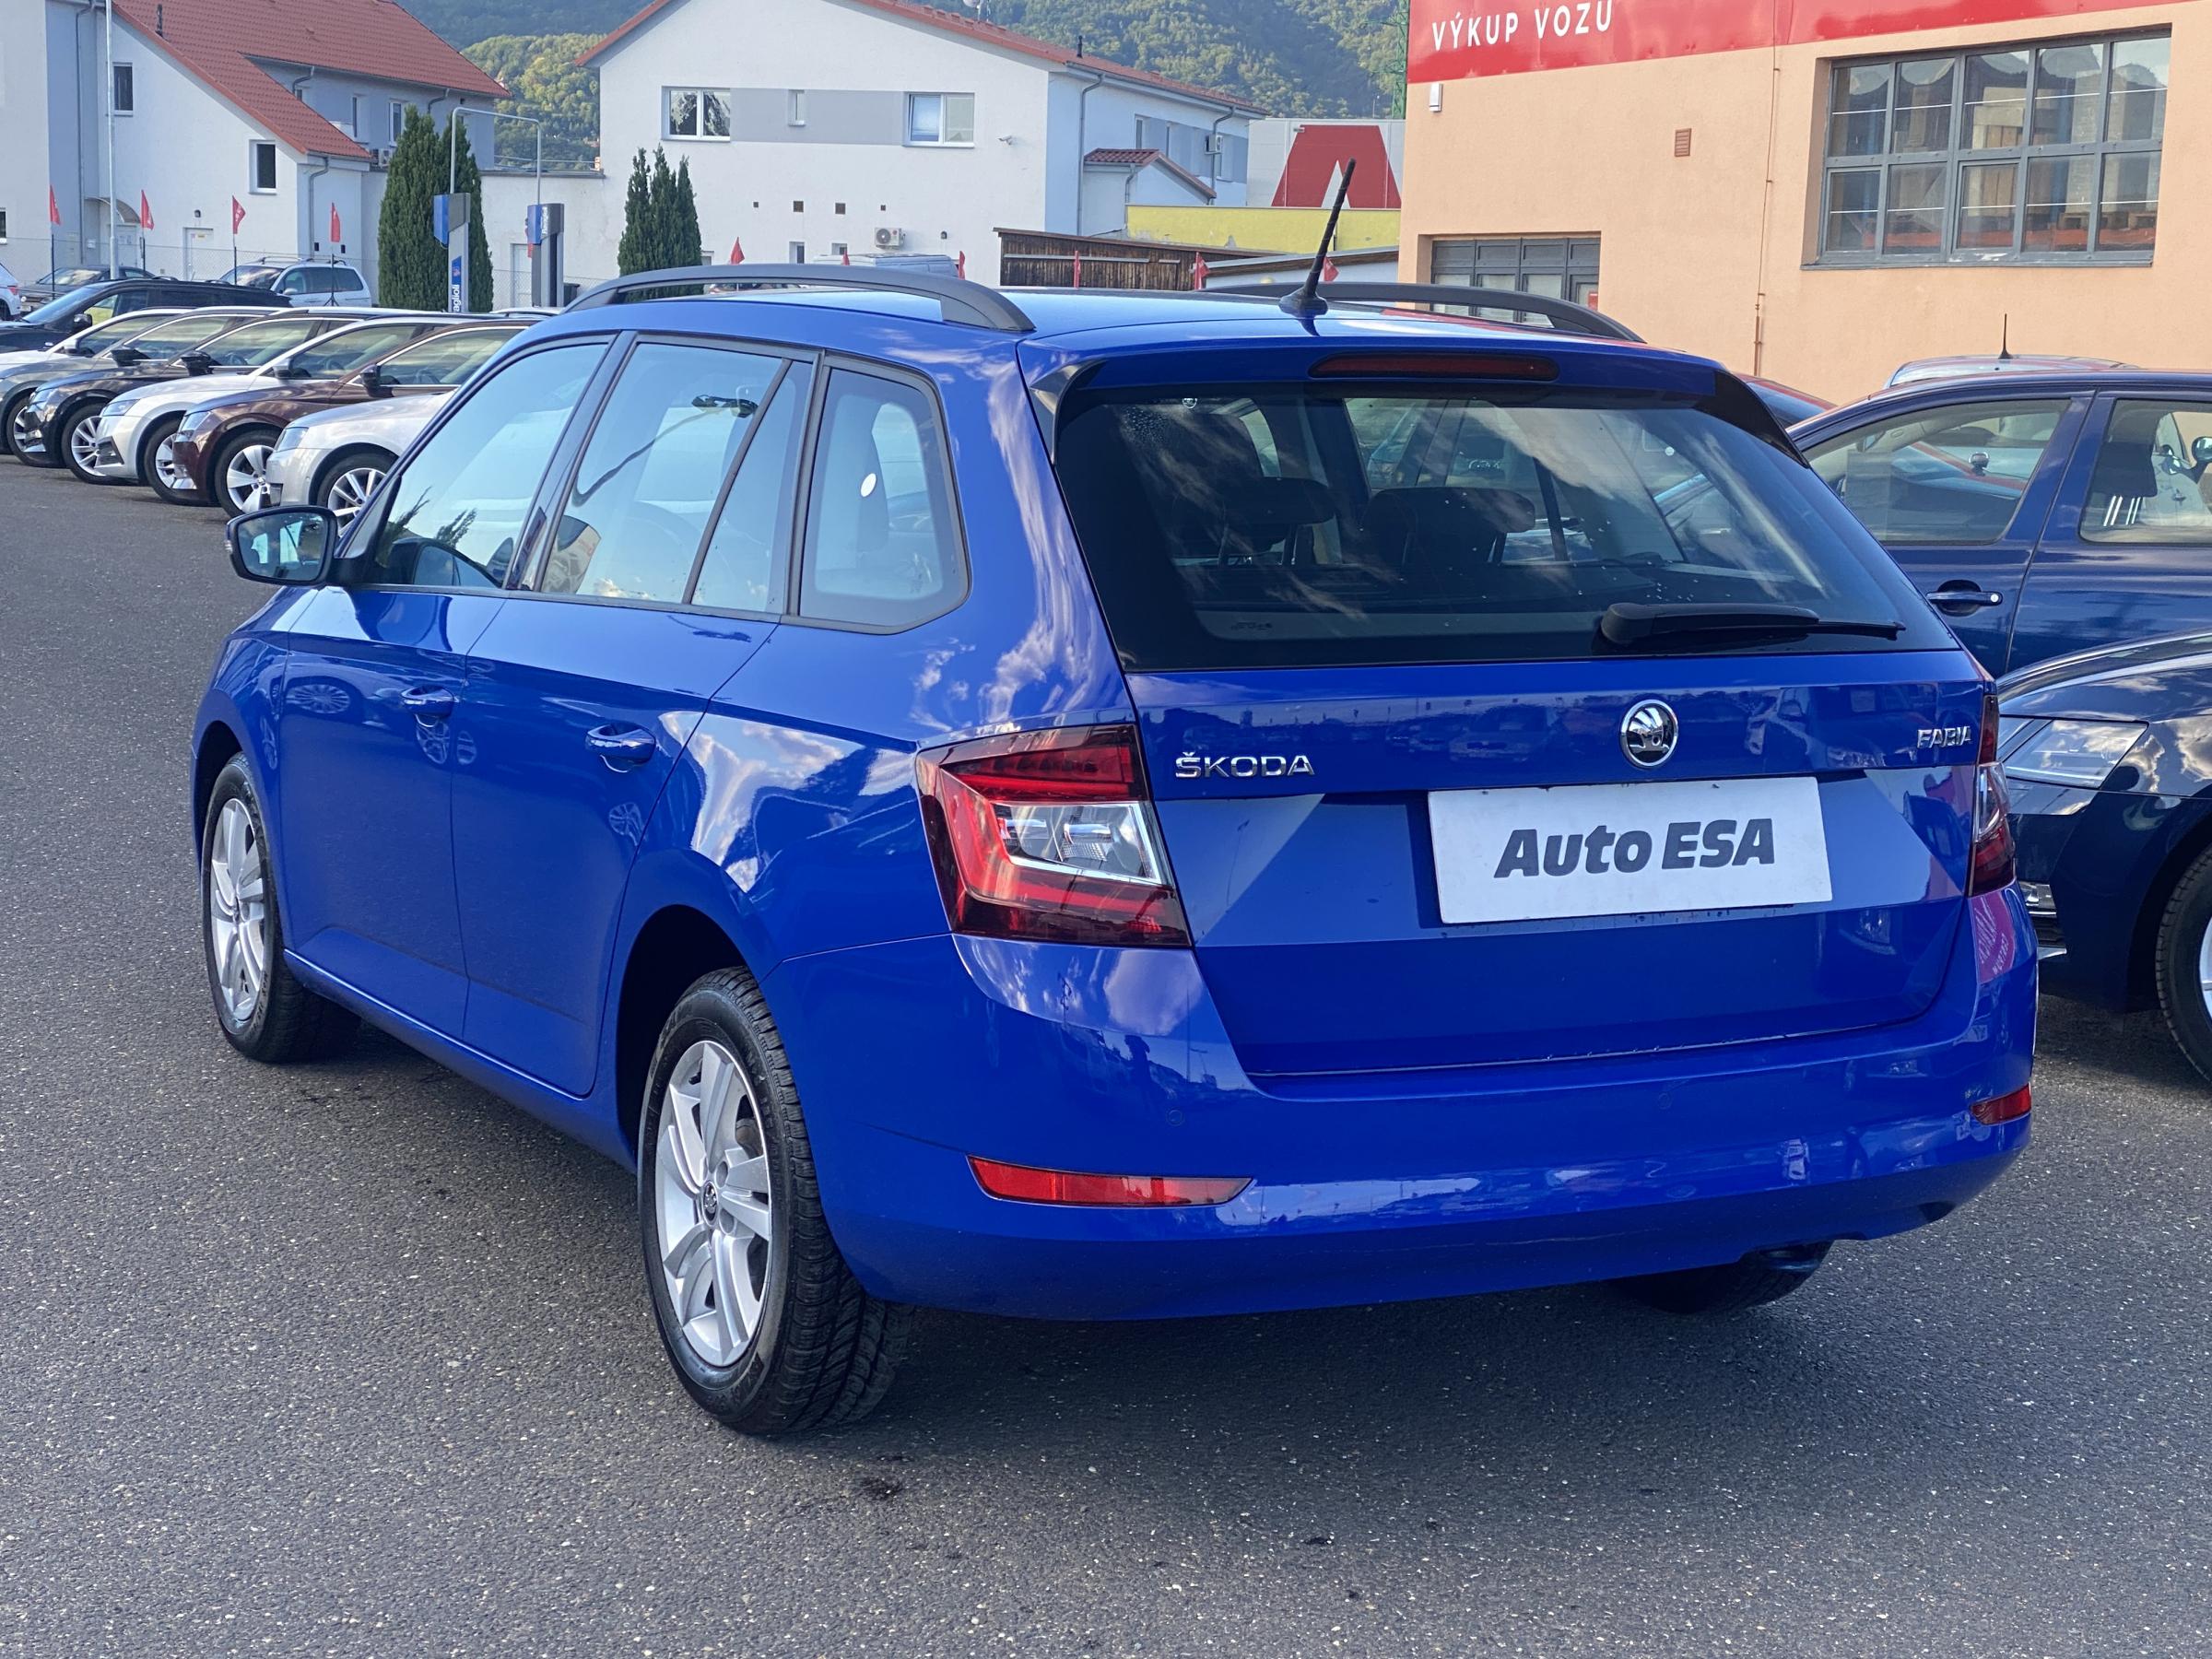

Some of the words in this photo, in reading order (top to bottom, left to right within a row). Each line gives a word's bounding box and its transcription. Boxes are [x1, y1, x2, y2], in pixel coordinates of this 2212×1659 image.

[1431, 11, 1519, 51] VÝKUP
[1917, 725, 1971, 748] FABIA
[1175, 751, 1315, 778] ŠKODA
[1493, 825, 1653, 878] Auto
[1661, 818, 1775, 869] ESA
